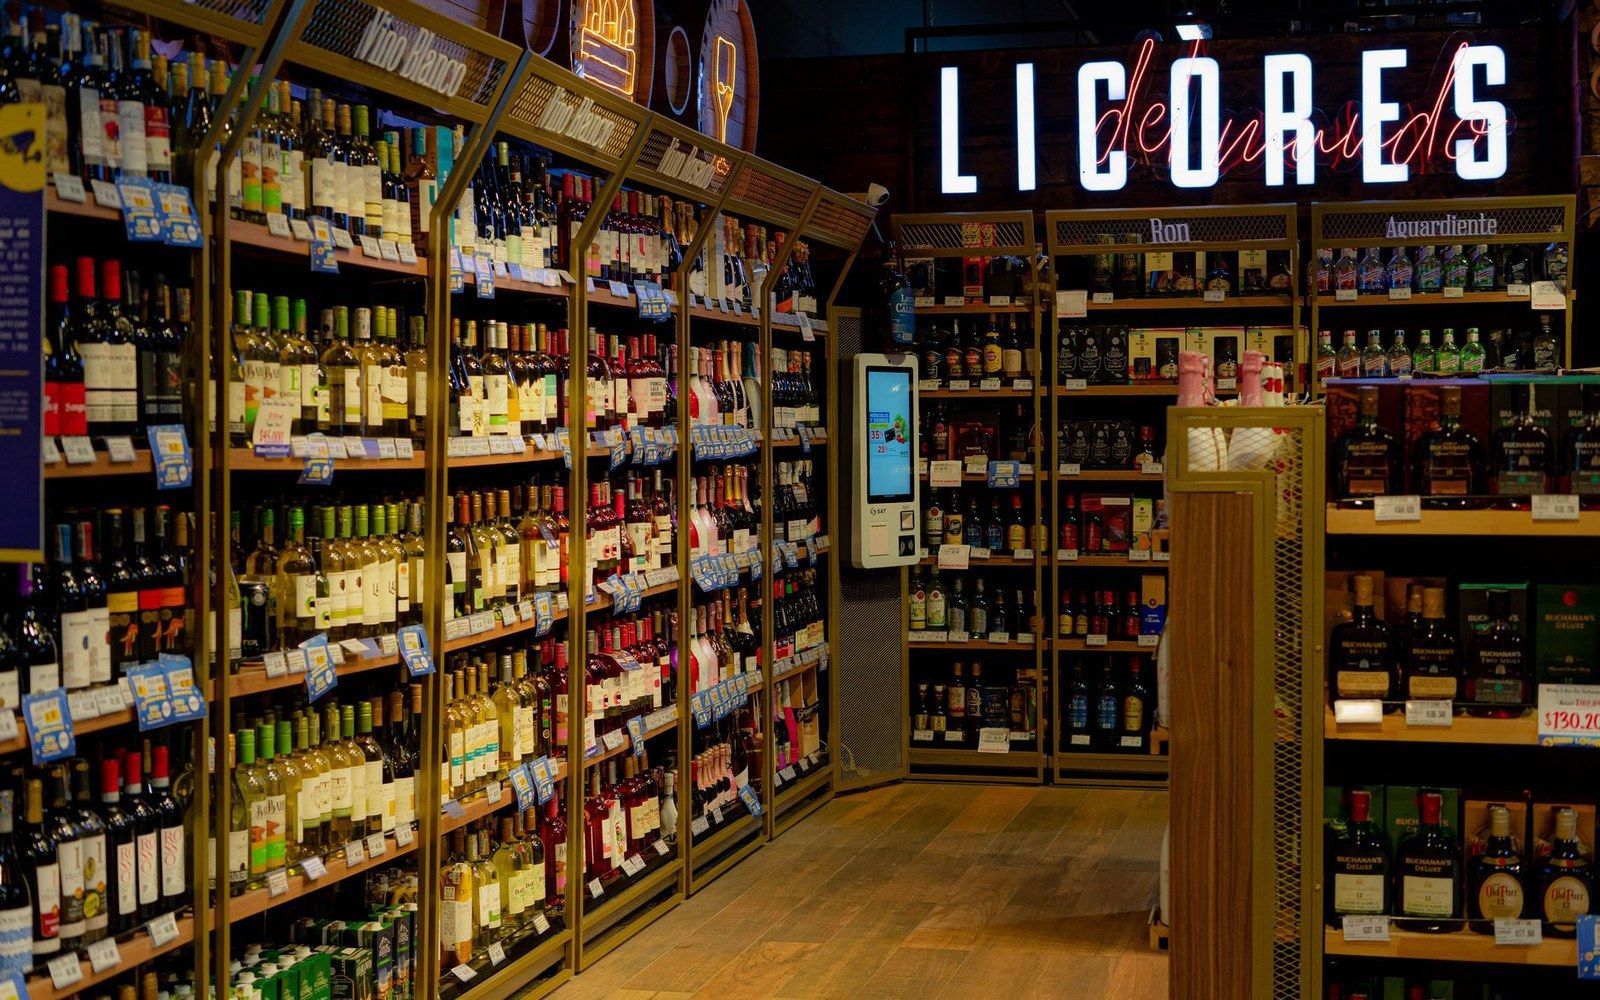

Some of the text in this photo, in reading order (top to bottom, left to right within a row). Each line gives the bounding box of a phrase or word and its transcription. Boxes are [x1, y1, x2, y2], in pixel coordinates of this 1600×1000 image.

[353, 8, 467, 98] Vino Blanco
[941, 44, 1508, 194] LICORES
[1149, 218, 1191, 243] Ron
[1385, 213, 1498, 239] Aguardiente
[1337, 856, 1382, 864] BUCHANAN'S
[1406, 858, 1452, 866] BUCHANAN'S
